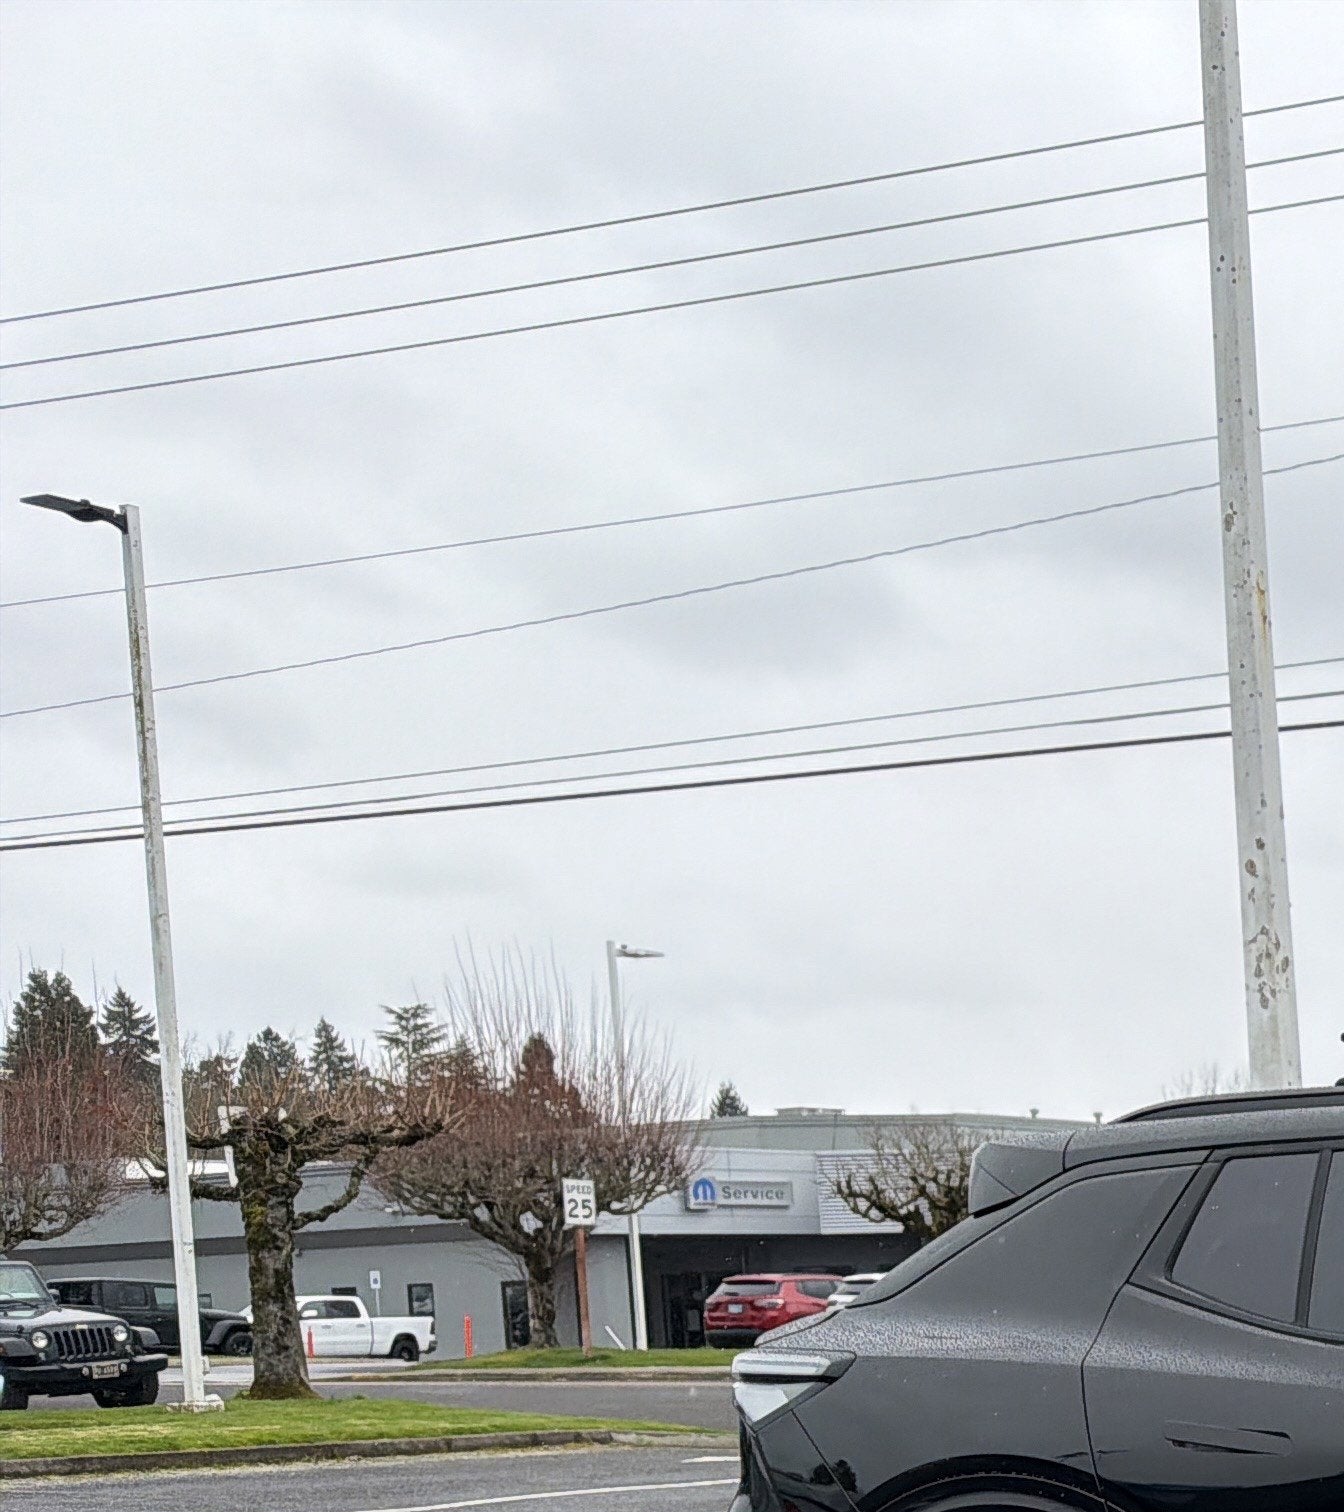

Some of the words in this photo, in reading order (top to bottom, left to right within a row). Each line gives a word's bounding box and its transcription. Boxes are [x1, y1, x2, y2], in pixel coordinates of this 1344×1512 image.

[565, 1183, 593, 1196] SPEED
[721, 1185, 784, 1201] Service
[567, 1198, 593, 1219] 25
